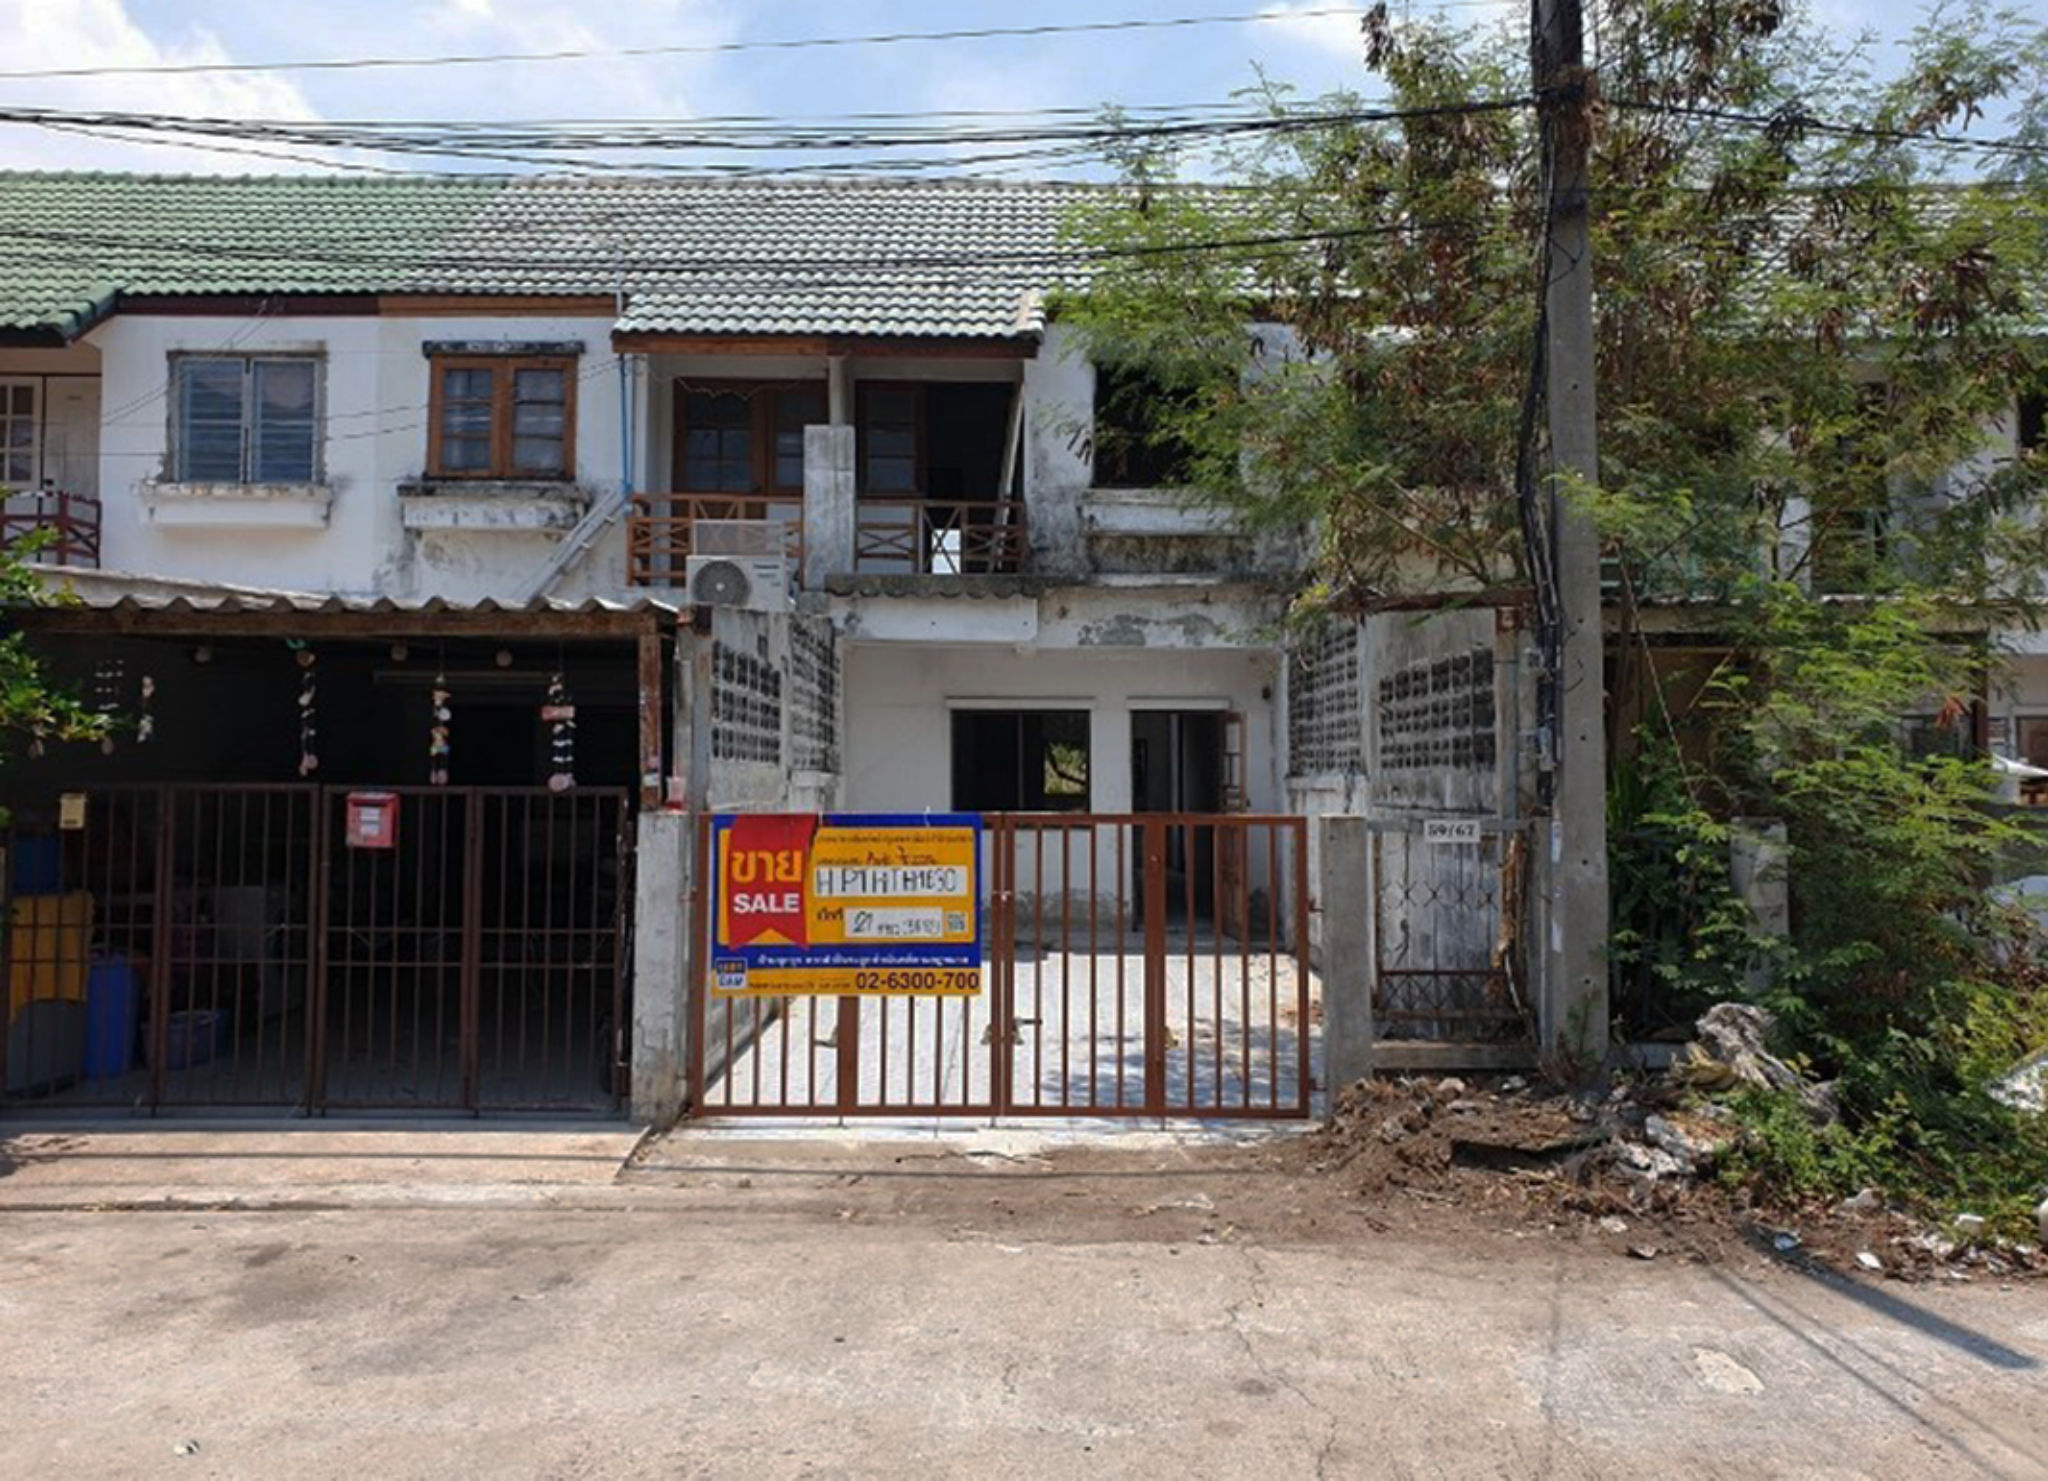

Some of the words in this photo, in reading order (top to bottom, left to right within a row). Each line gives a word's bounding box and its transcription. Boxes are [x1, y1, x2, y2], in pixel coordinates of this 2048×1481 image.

[732, 850, 802, 883] ขาย
[733, 892, 800, 914] SALE
[855, 972, 980, 990] 02-6300-700
